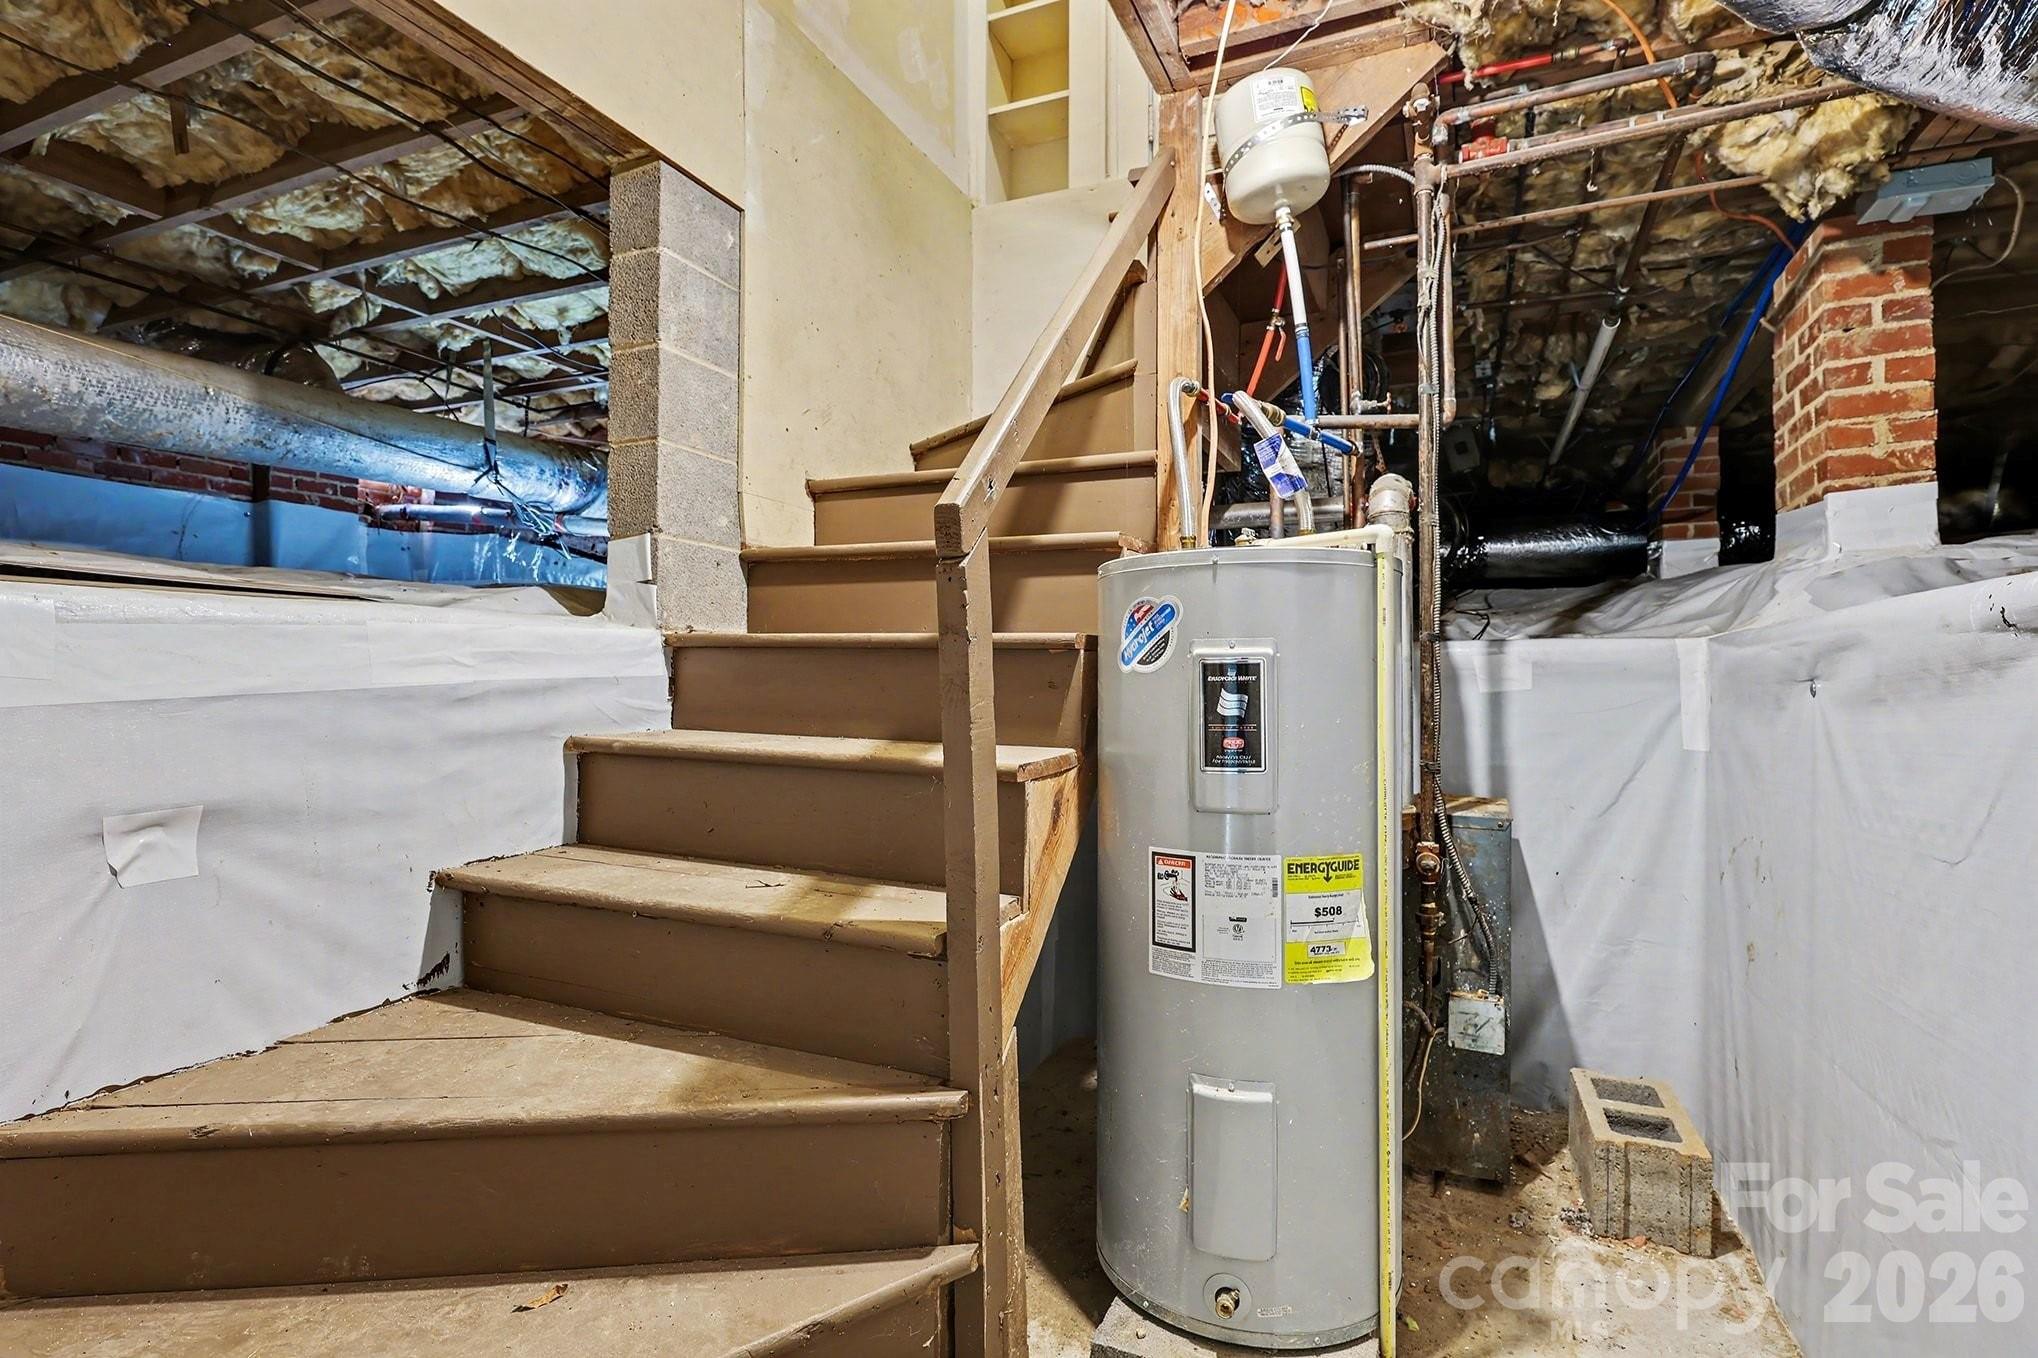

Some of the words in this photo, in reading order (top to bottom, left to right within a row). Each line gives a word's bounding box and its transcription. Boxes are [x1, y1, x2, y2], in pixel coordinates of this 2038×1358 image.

[1287, 859, 1360, 876] ENERGYGUIDE
[1314, 905, 1343, 918] $508
[1310, 945, 1332, 953] 4773
